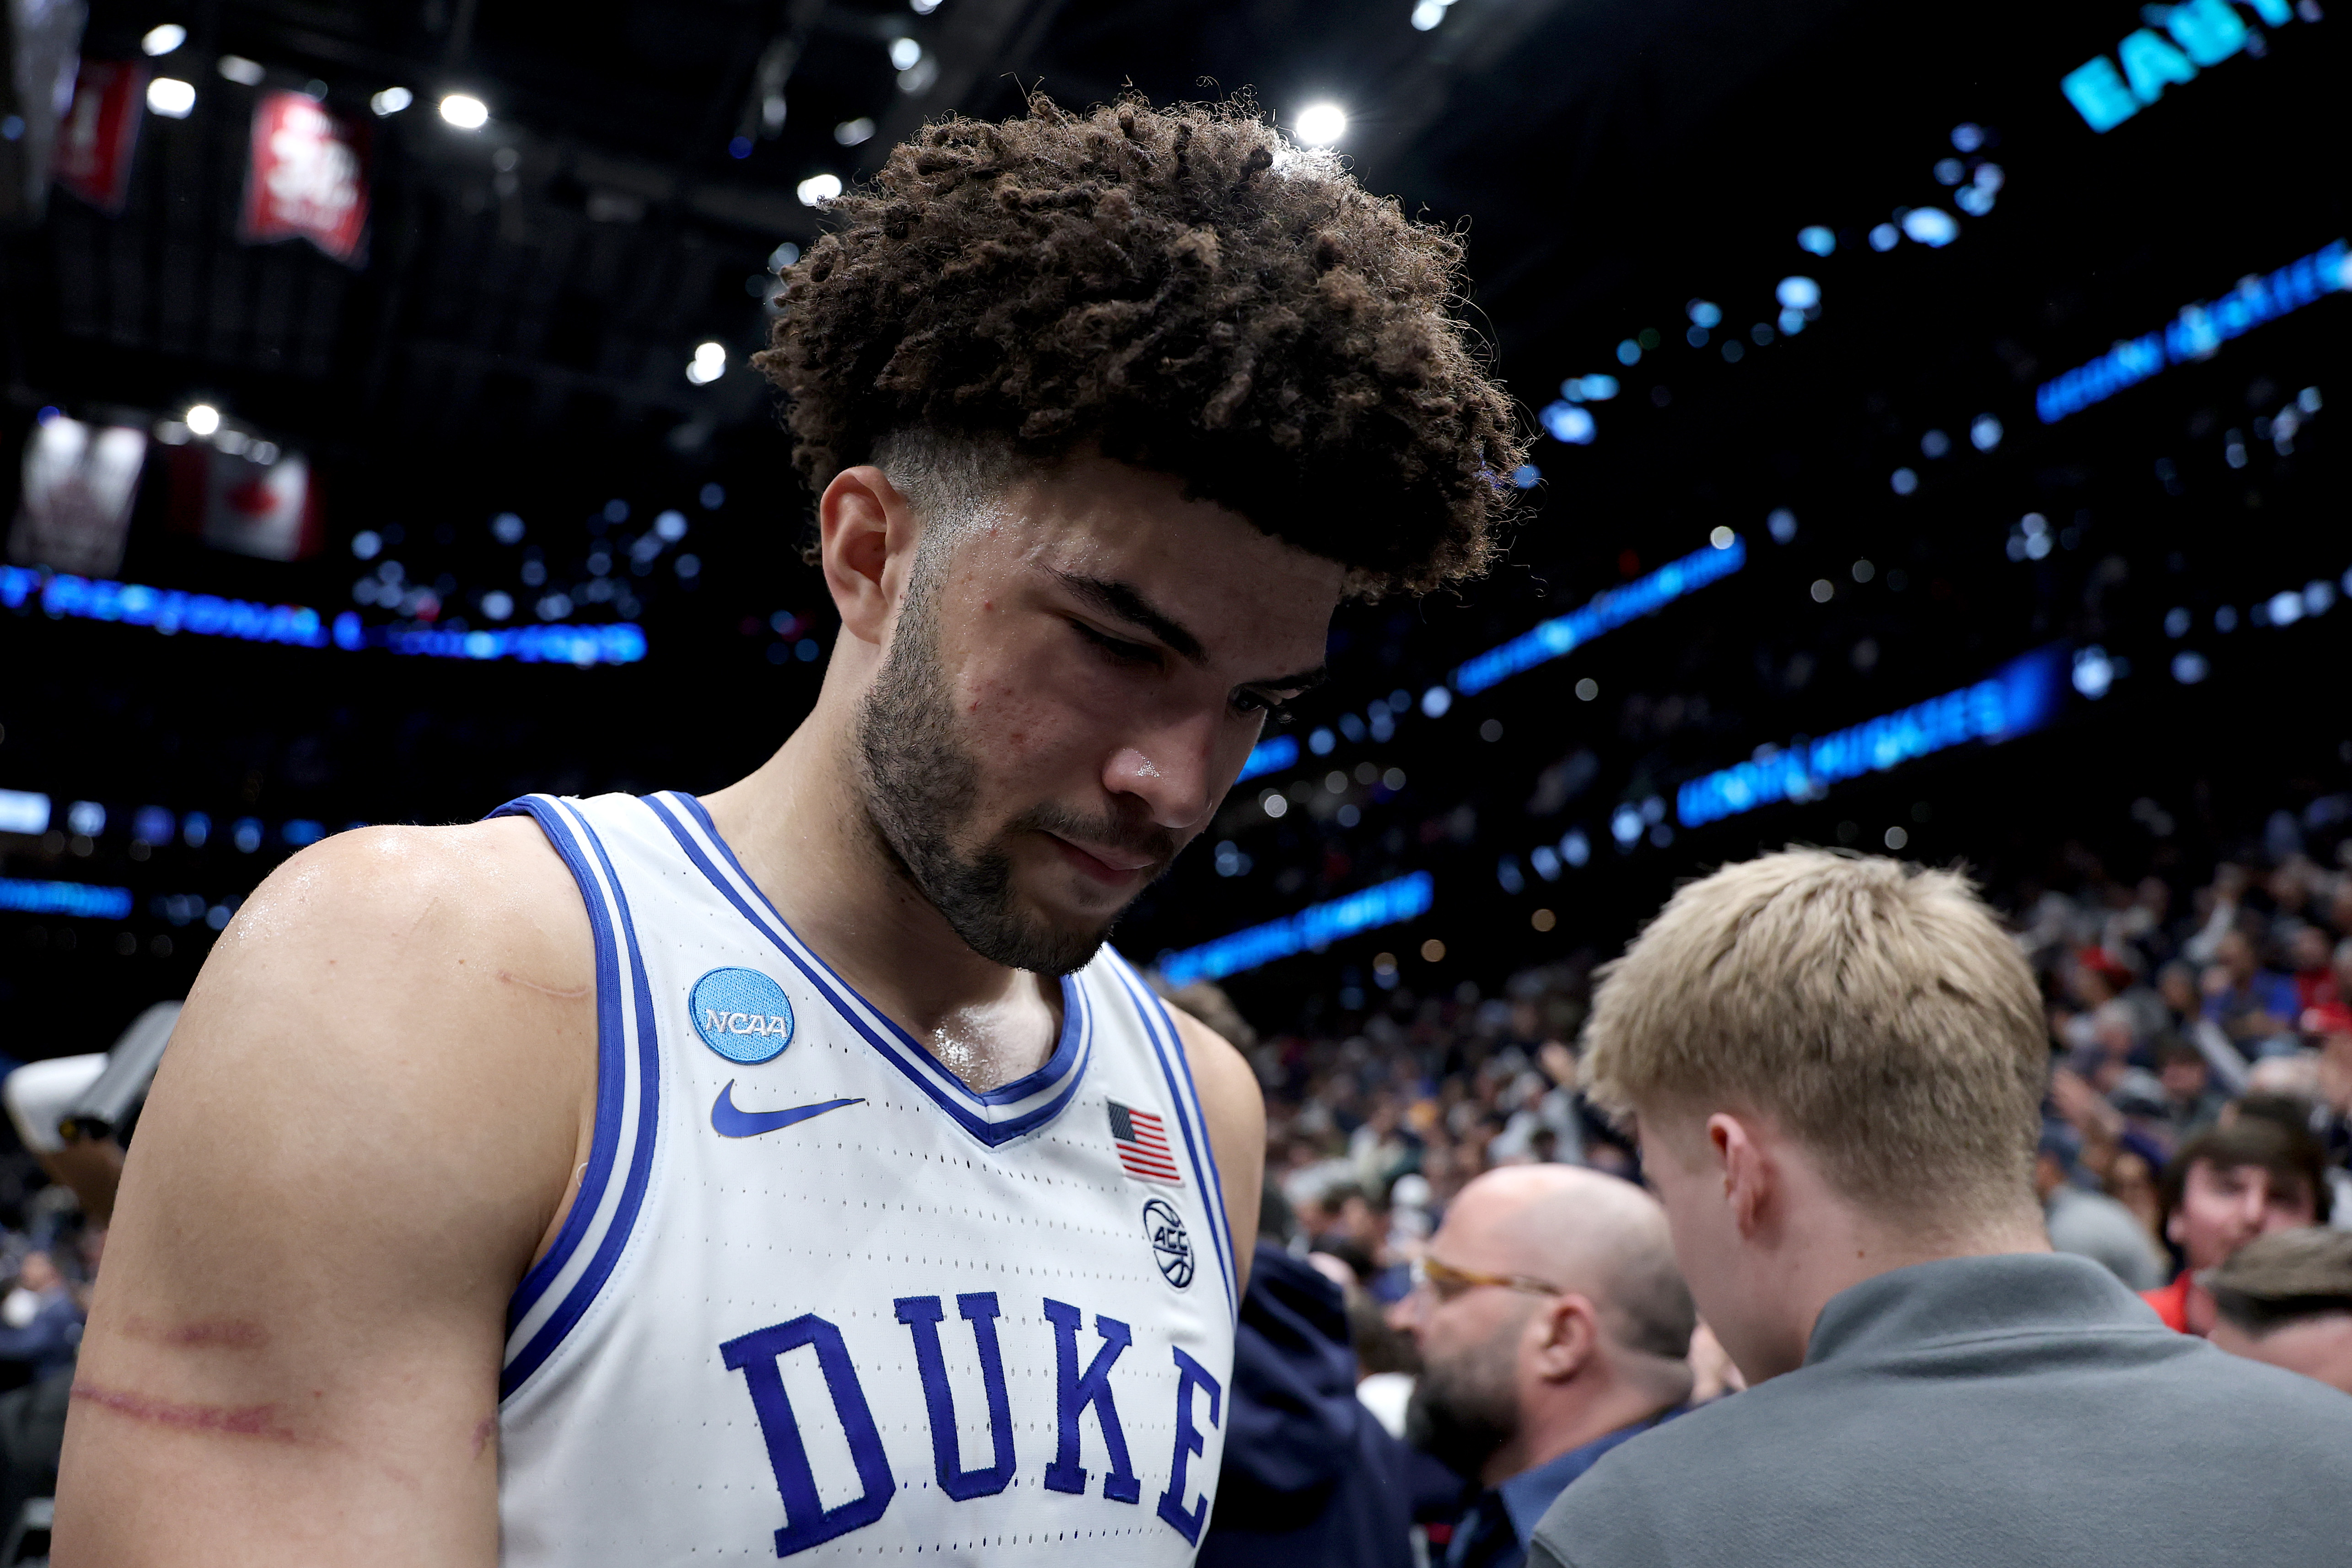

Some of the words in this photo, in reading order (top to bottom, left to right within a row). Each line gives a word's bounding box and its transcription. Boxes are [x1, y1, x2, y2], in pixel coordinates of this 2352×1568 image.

[706, 1009, 788, 1037] NCAA
[1154, 1226, 1187, 1251] ACC
[720, 1291, 1221, 1558] DUKE
